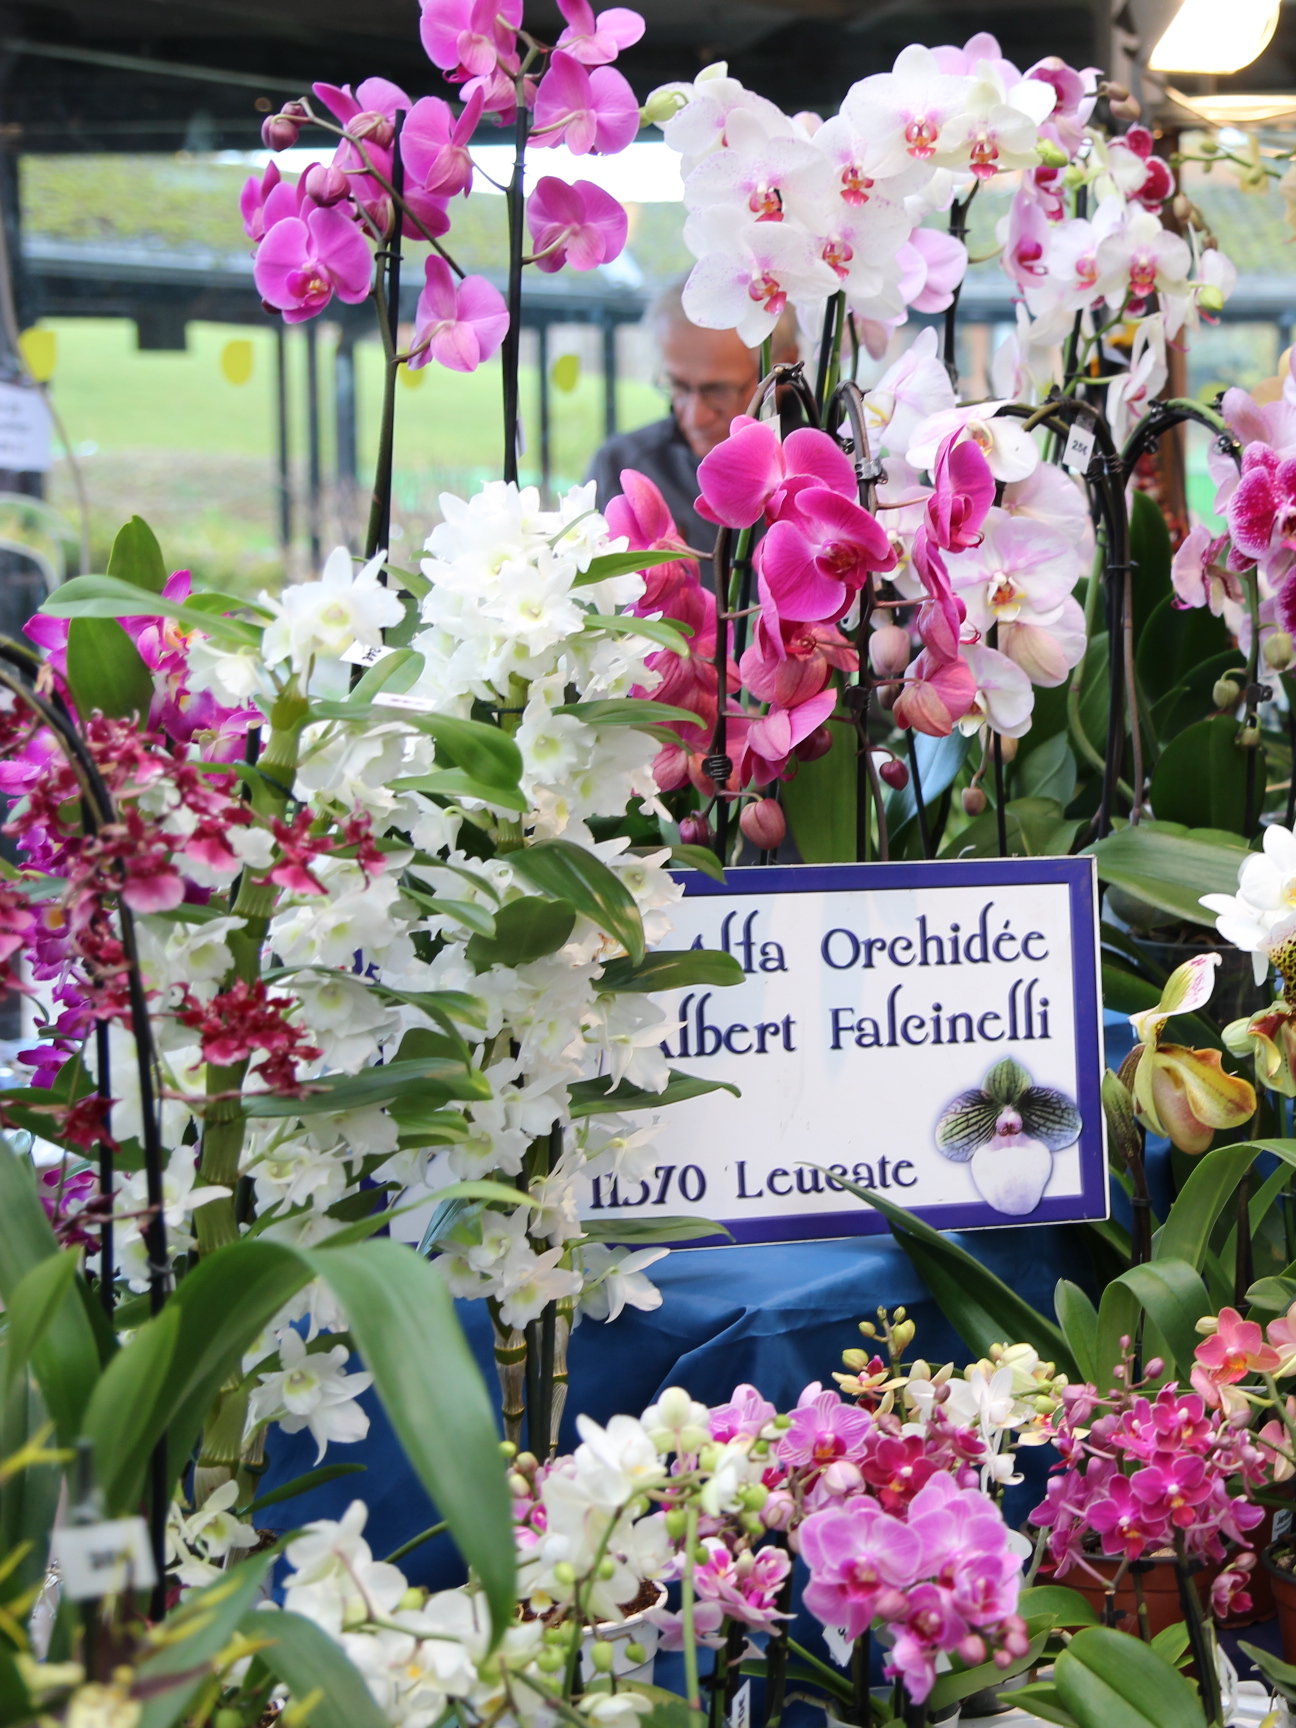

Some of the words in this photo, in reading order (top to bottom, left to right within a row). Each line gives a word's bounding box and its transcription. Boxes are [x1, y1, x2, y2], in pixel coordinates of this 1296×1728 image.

[690, 910, 789, 974] lfa
[820, 901, 1050, 970] Orchidée
[659, 992, 797, 1059] lbert
[828, 977, 1053, 1051] Falcinelli
[735, 1154, 919, 1199] Leucate
